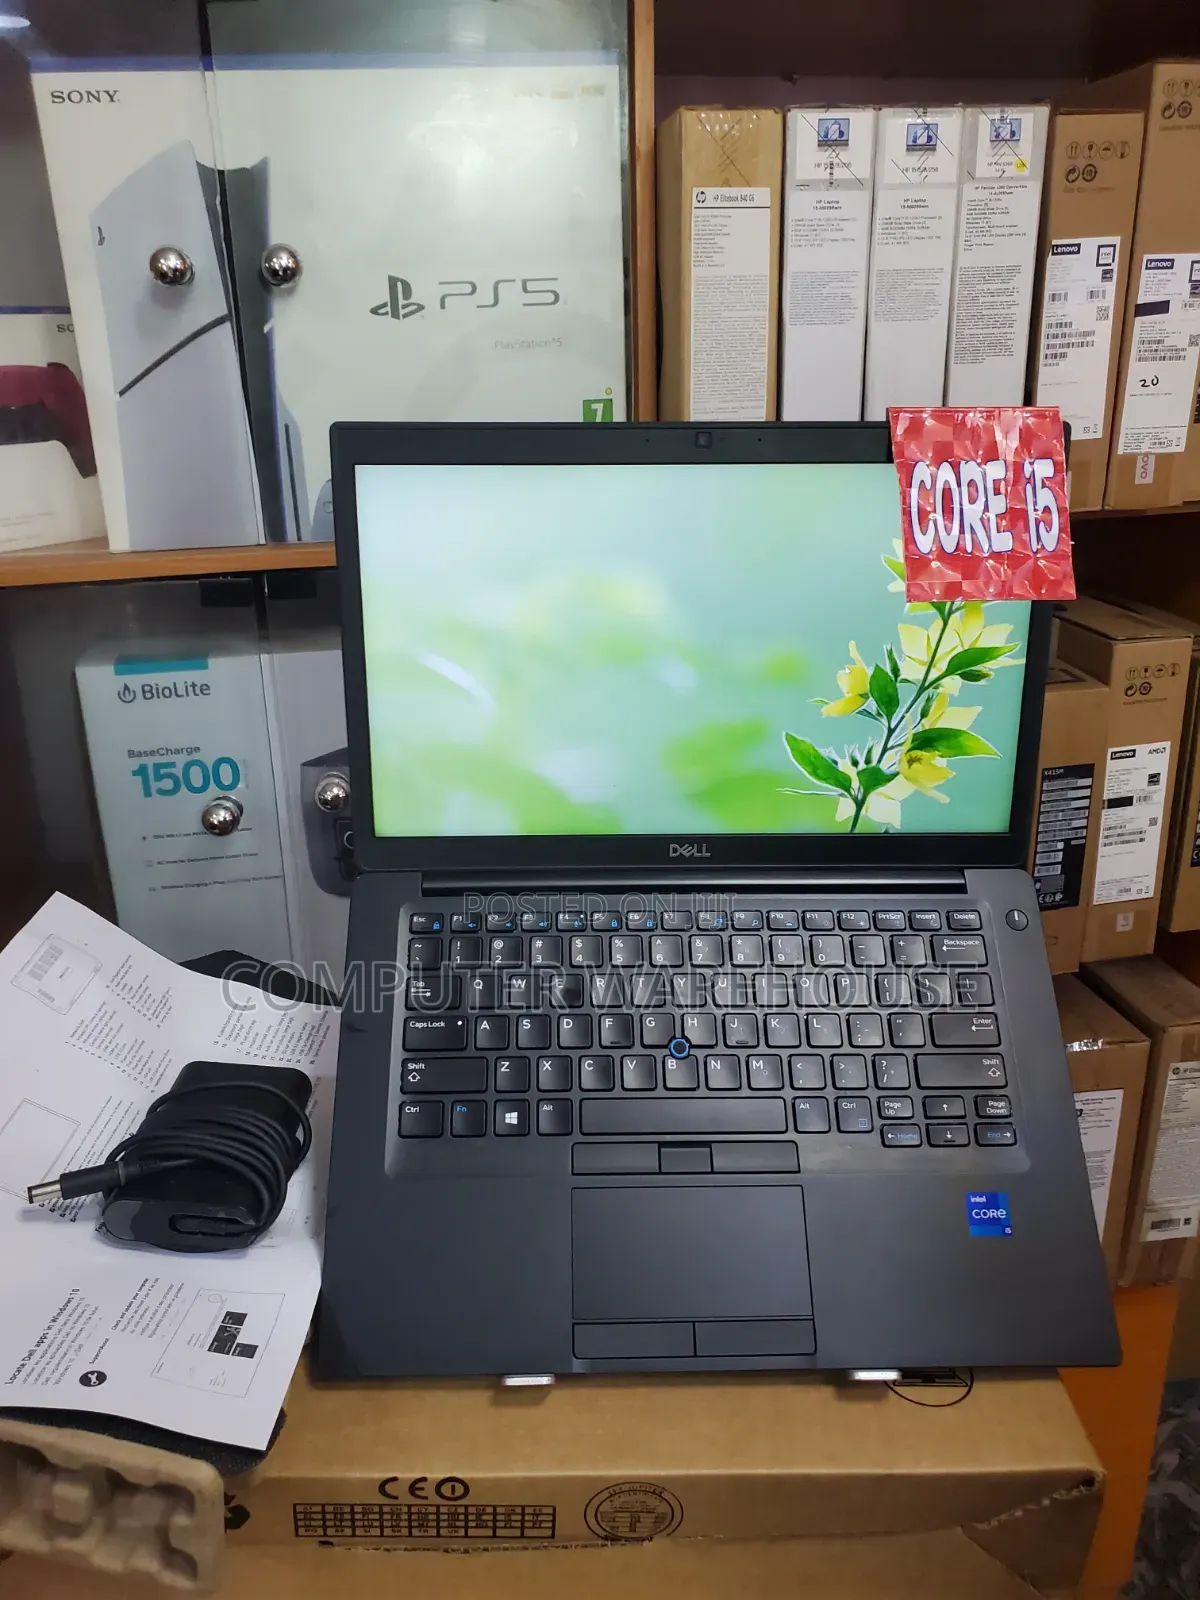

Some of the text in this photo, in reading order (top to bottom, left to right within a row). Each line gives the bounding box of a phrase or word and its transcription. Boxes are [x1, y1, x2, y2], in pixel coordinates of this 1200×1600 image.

[50, 90, 119, 104] SONY
[713, 194, 719, 202] HP
[1053, 245, 1079, 254] Lenovo
[1147, 259, 1172, 268] Lenovo
[438, 277, 561, 310] PS5
[1138, 375, 1160, 388] 20
[910, 457, 1061, 557] CORE i5
[141, 680, 212, 701] BioLite
[127, 744, 201, 759] BaseCharge
[1112, 750, 1134, 759] Lenovo
[131, 756, 241, 799] 1500
[669, 844, 711, 858] DELL
[575, 938, 583, 948] $
[614, 939, 624, 948] %
[943, 938, 980, 946] Backspace
[495, 954, 502, 963] 2
[535, 954, 543, 963] 3
[575, 954, 583, 962] 4
[616, 954, 623, 962] 5
[656, 954, 664, 962] 6
[696, 954, 703, 962] 7
[737, 953, 744, 962] 8
[778, 954, 785, 962] 9
[818, 953, 826, 962] 0
[473, 979, 484, 990] Q
[512, 978, 527, 989] W
[555, 978, 564, 988] E
[596, 978, 605, 988] R
[636, 978, 645, 988] T
[677, 978, 686, 987] Y
[718, 978, 727, 987] U
[800, 978, 810, 987] O
[841, 978, 850, 987] P
[409, 1017, 992, 1030] Caps Lock A S D F G H J K L Enter
[407, 1062, 425, 1070] Shift
[500, 1061, 510, 1072] Z
[542, 1060, 552, 1071] X
[584, 1060, 594, 1071] C
[626, 1059, 637, 1070] V
[667, 1059, 677, 1069] B
[711, 1059, 721, 1070] N
[752, 1059, 764, 1070] M
[456, 1105, 467, 1113] Fn
[884, 1101, 902, 1109] Page
[988, 1100, 1006, 1108] Page
[970, 1195, 987, 1203] intel
[4, 1288, 80, 1385] Locate Dell apps in Windows 10
